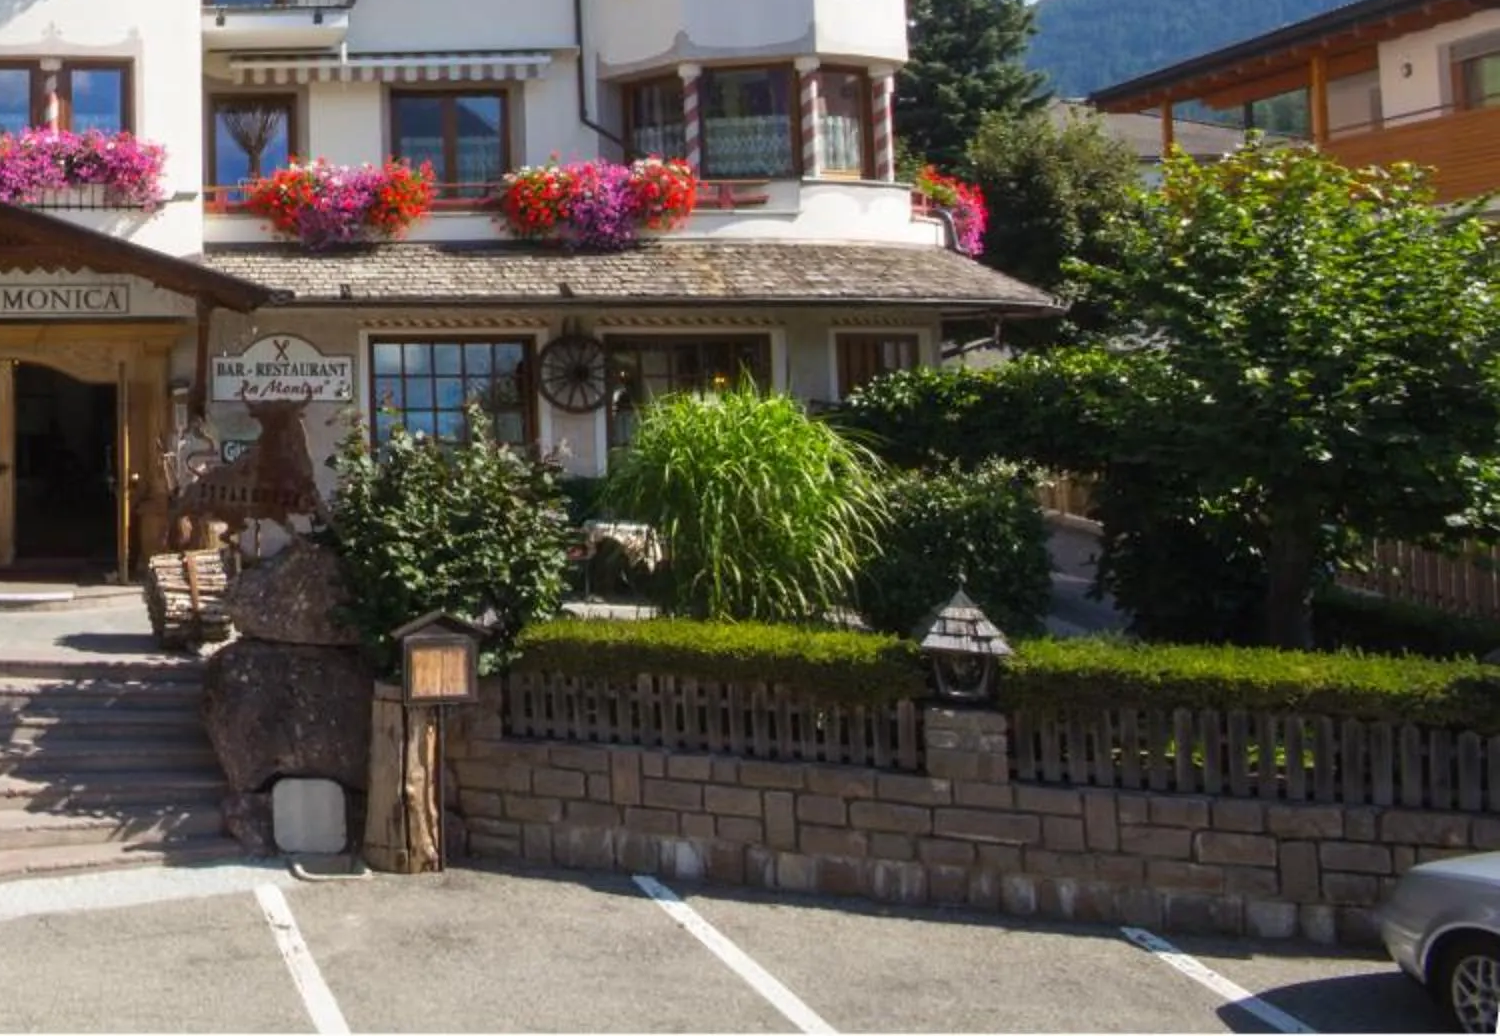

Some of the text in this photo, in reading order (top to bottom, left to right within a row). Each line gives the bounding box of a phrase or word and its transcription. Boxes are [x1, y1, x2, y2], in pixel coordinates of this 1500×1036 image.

[2, 287, 122, 310] MONICA
[217, 362, 245, 377] BAR
[255, 362, 348, 377] RESTAURANT
